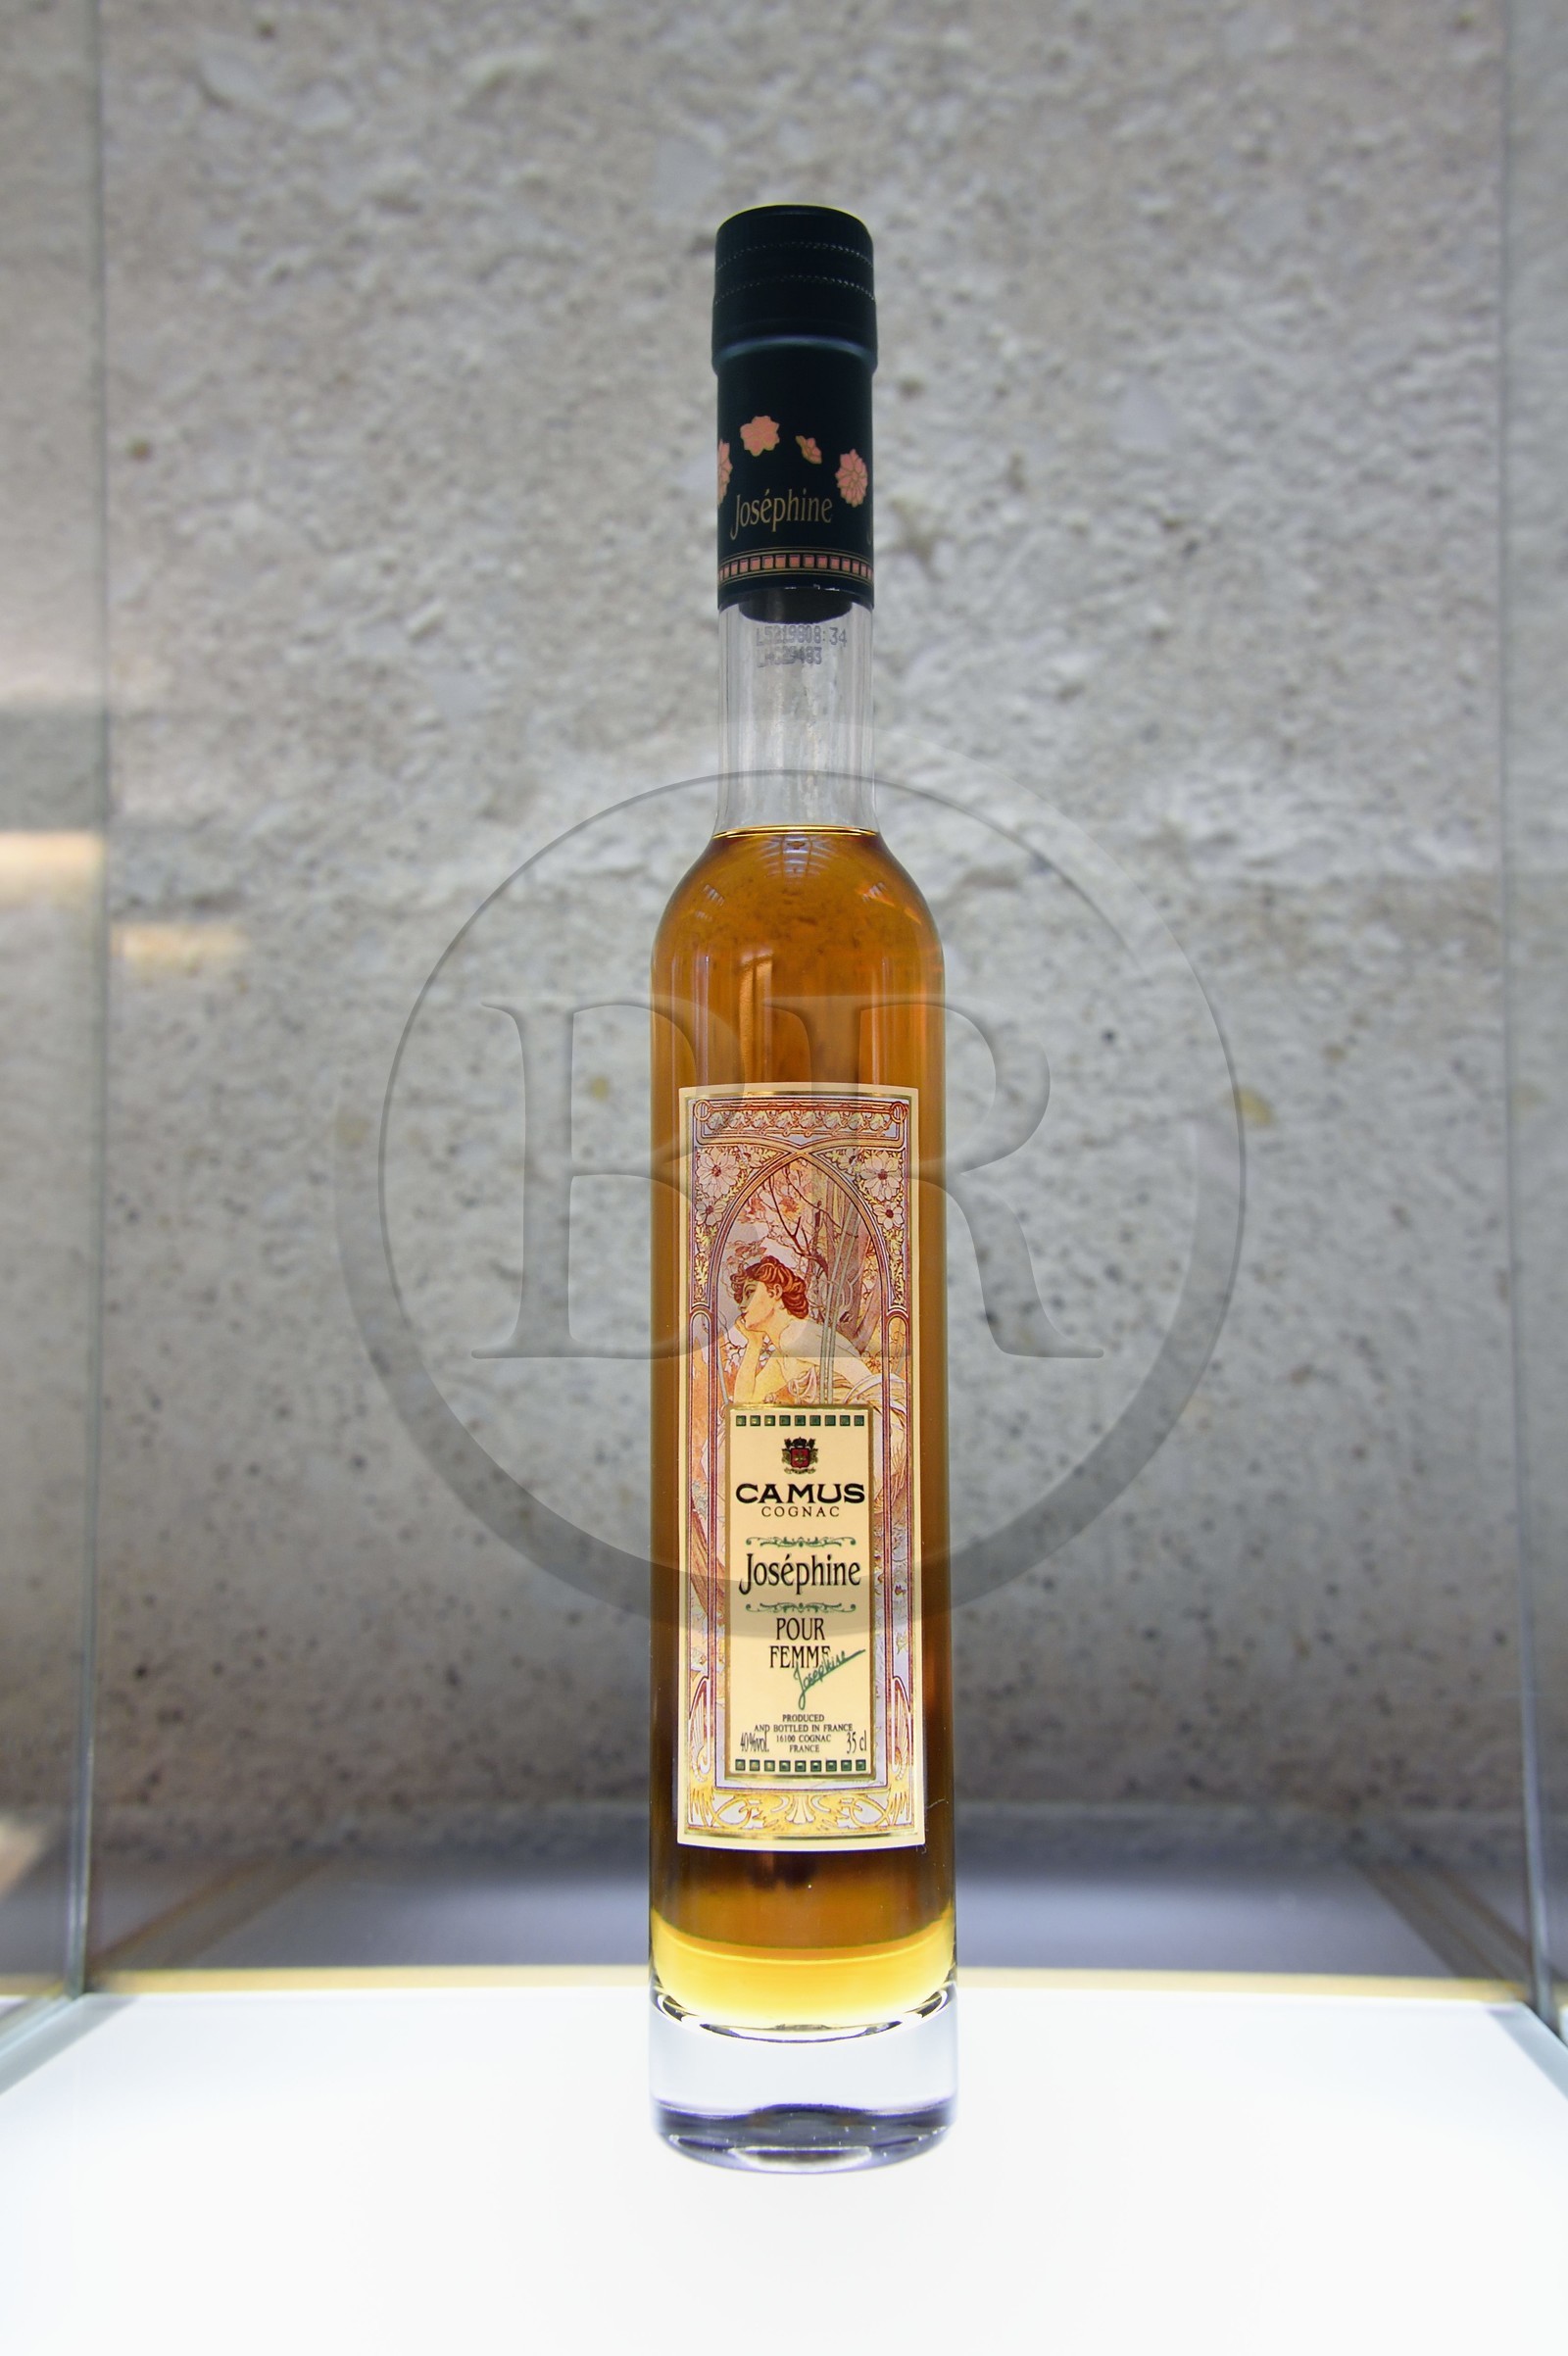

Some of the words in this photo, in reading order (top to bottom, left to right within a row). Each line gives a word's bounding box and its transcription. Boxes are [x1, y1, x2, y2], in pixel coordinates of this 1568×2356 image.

[730, 489, 833, 541] Joséphine
[735, 1483, 865, 1504] CAMUS
[760, 1505, 841, 1518] COGNAC
[738, 1552, 861, 1595] Joséphine
[775, 1617, 826, 1641] POUR
[782, 1714, 825, 1723] PRODUCED
[823, 1723, 854, 1733] FRANCE
[776, 1734, 796, 1743] 16100
[799, 1734, 832, 1742] COGNAC
[846, 1731, 858, 1754] 35
[858, 1730, 867, 1751] cl
[789, 1744, 820, 1753] FRANCE
